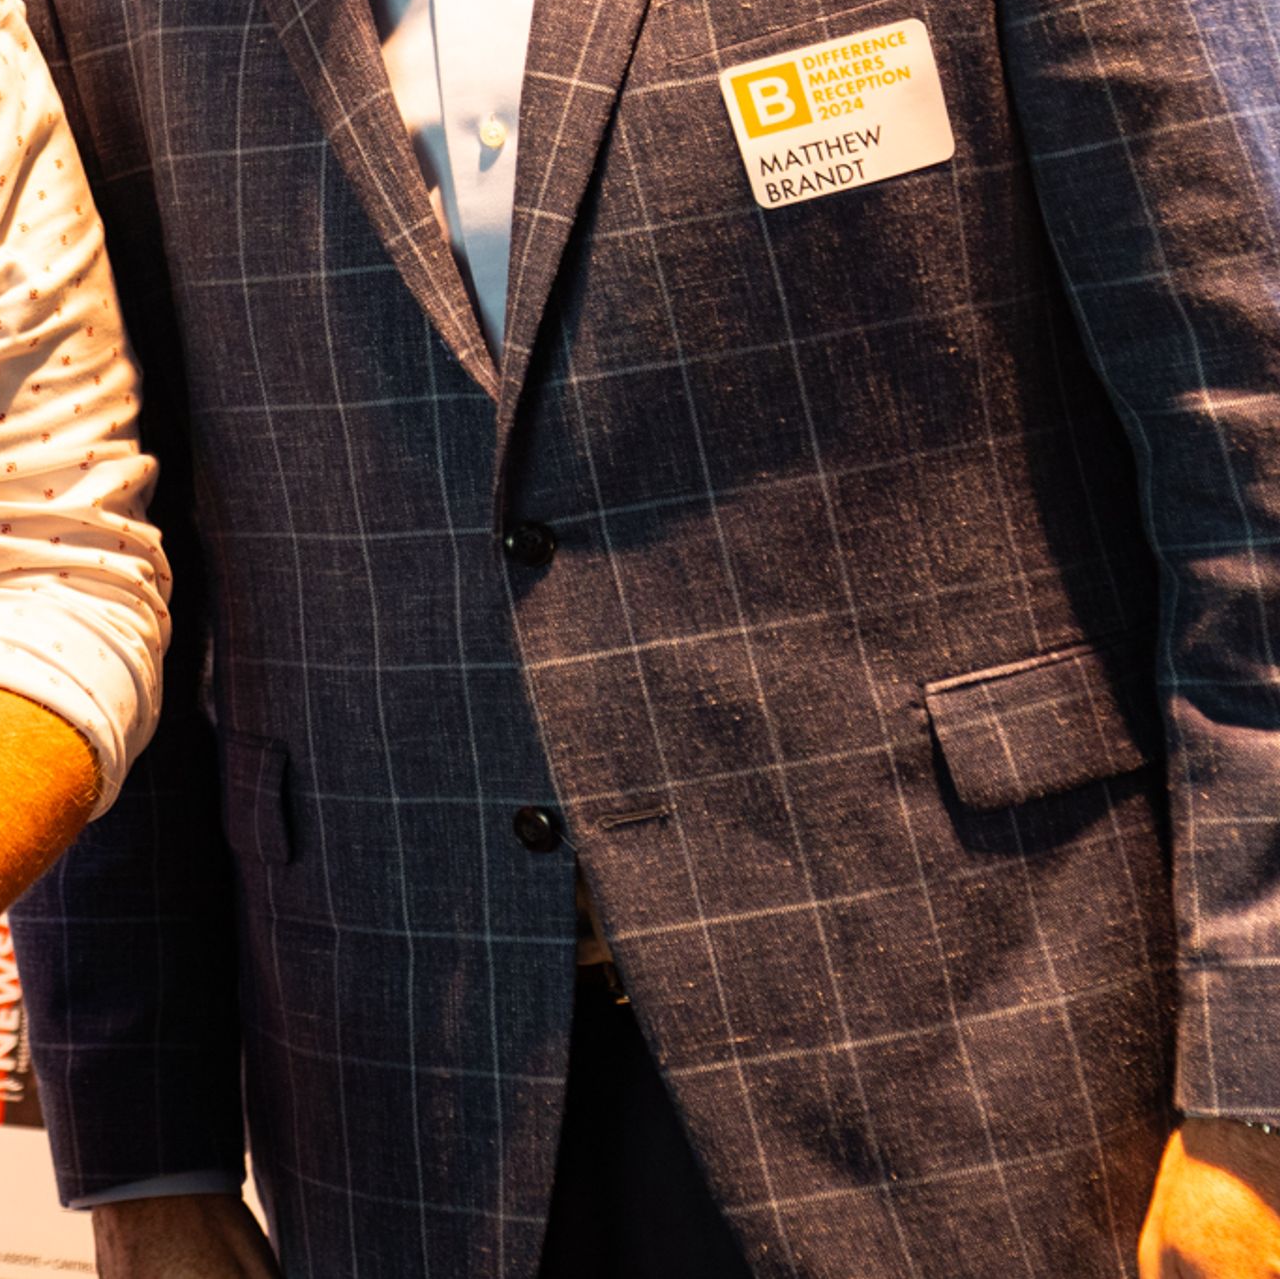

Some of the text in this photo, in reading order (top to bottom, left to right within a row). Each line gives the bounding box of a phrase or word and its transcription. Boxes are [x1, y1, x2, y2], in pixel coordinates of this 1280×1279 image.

[802, 31, 907, 70] DIFFERENCE
[808, 55, 885, 87] MAKERS
[812, 66, 911, 104] RECEPTION
[747, 75, 797, 127] B
[818, 97, 864, 121] 2024
[759, 125, 882, 177] MATTHEW
[765, 159, 866, 204] BRANDT
